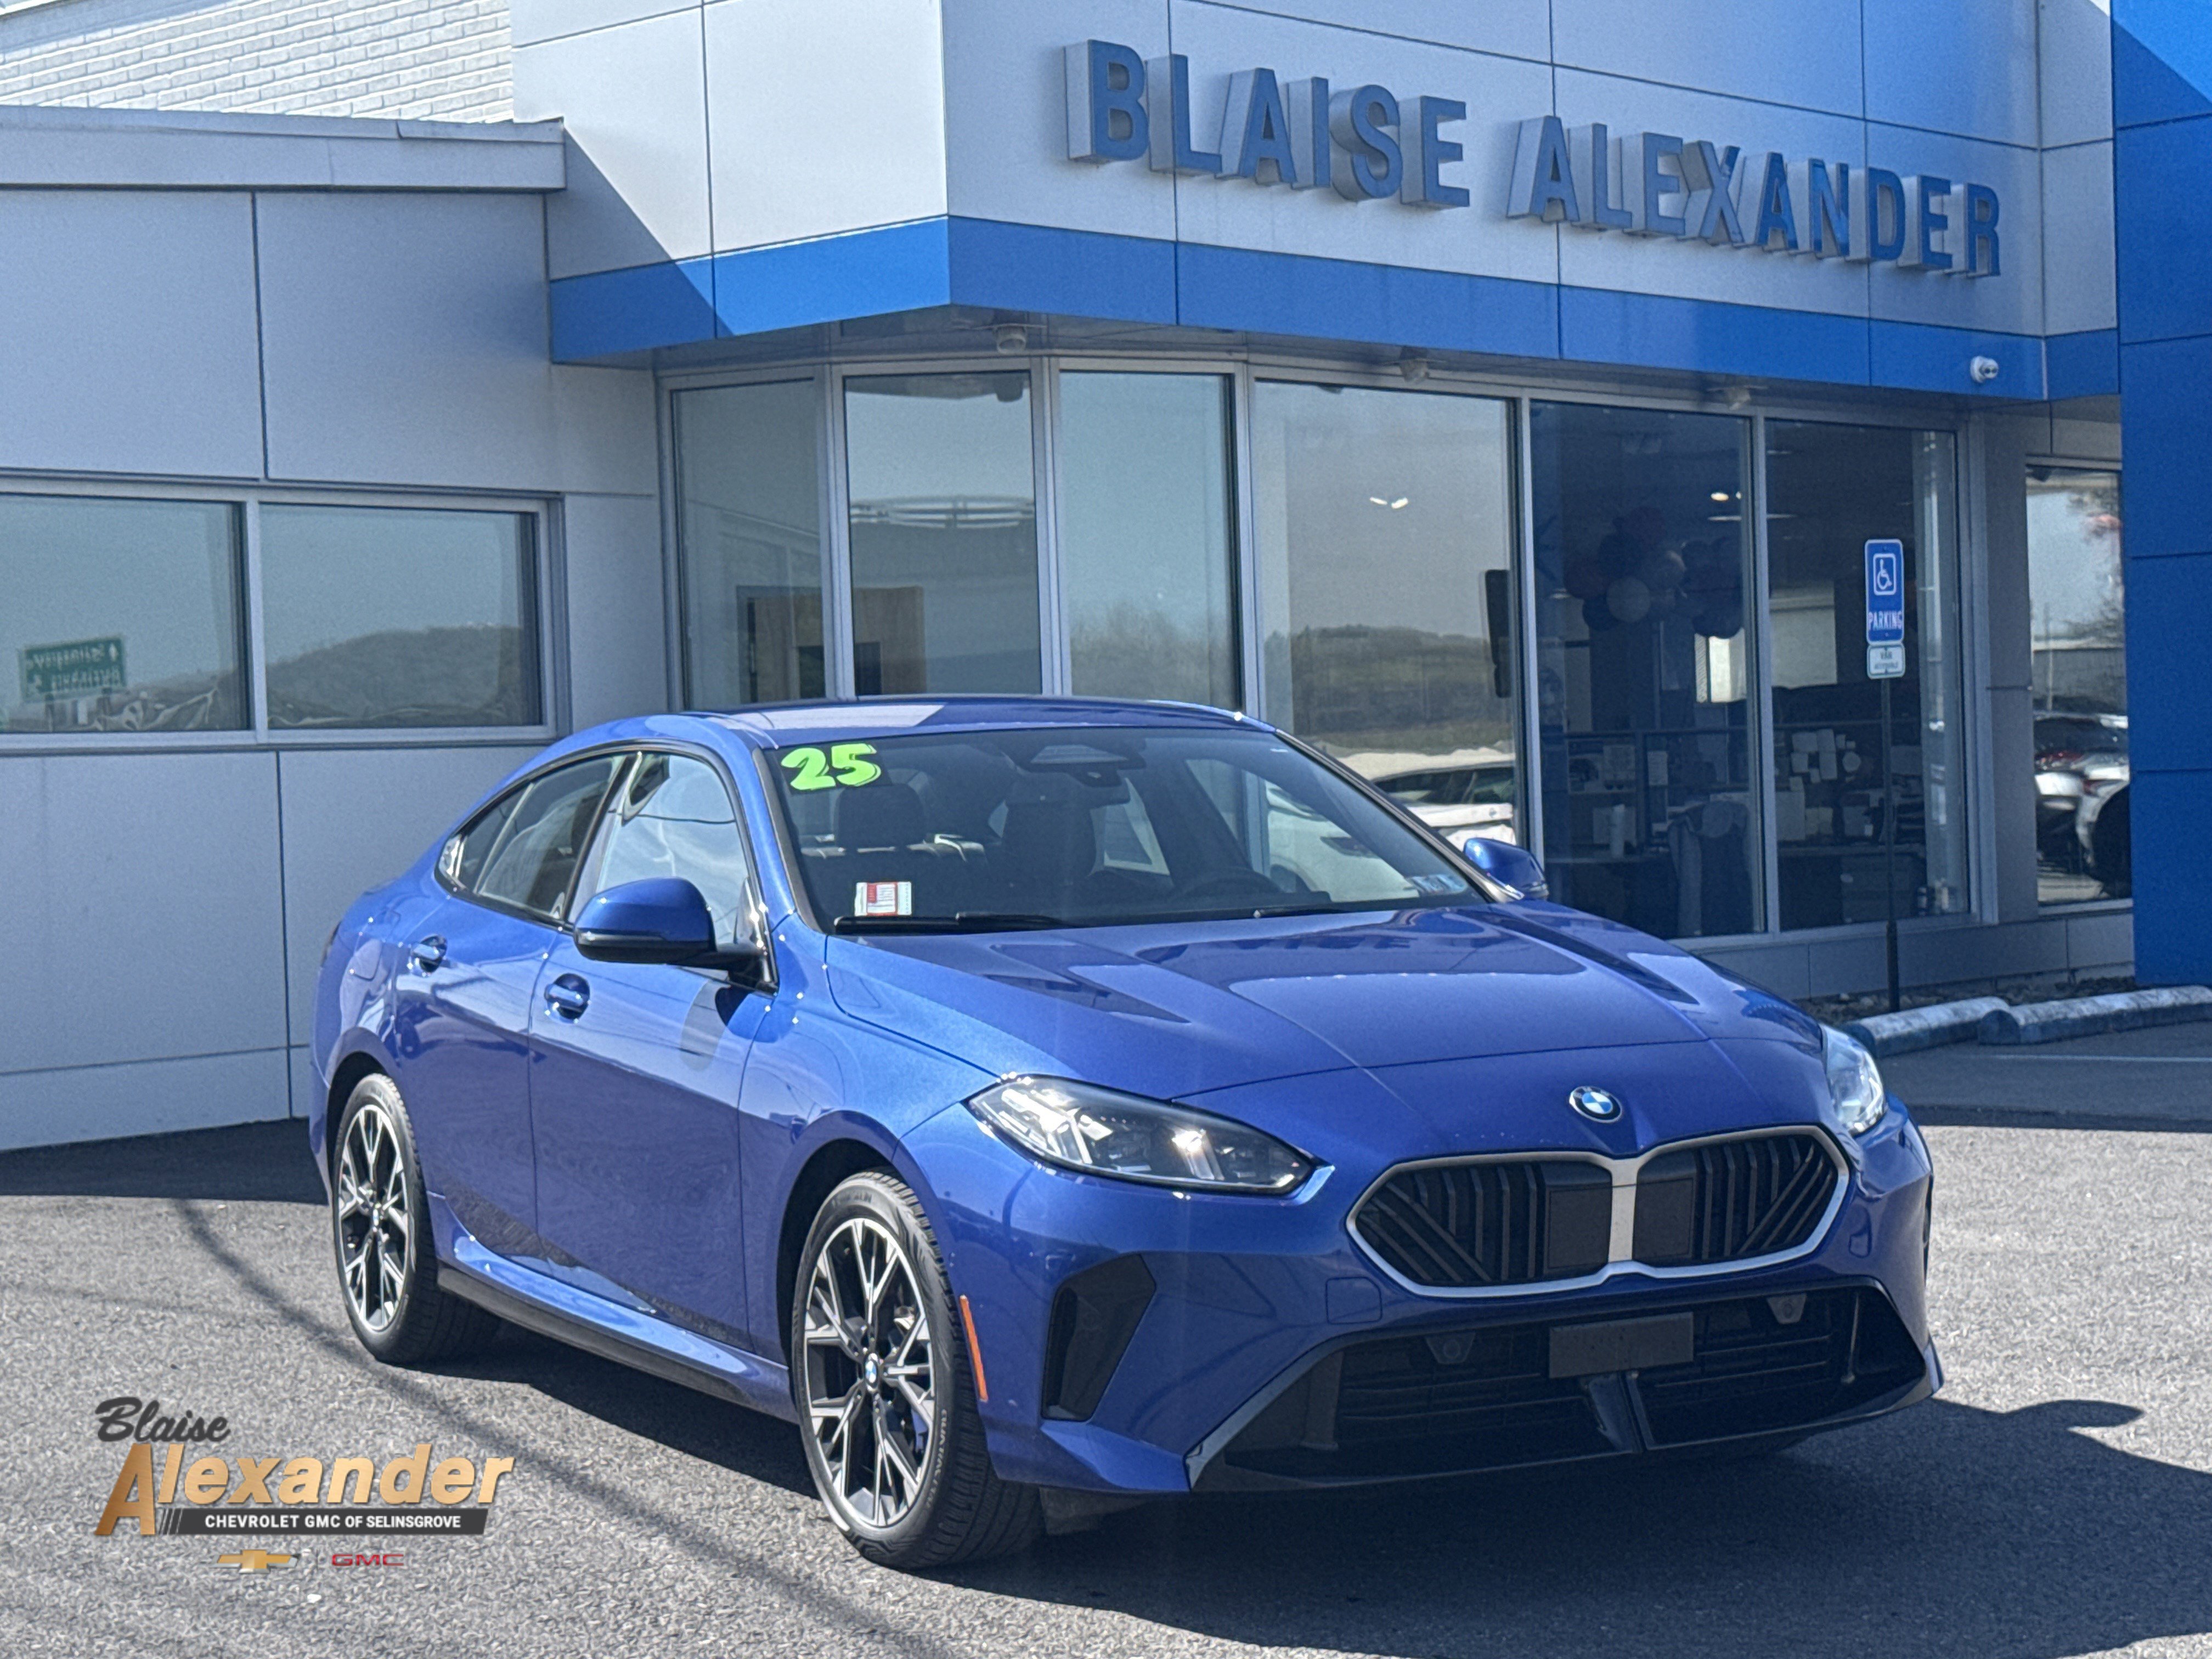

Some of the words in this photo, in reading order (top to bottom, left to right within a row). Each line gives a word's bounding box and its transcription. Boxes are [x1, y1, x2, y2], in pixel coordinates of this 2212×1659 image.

[1088, 38, 1470, 210] BLAISE
[1528, 114, 2001, 276] ALEXANDER
[1868, 611, 1902, 630] PARKING
[780, 743, 882, 791] 25
